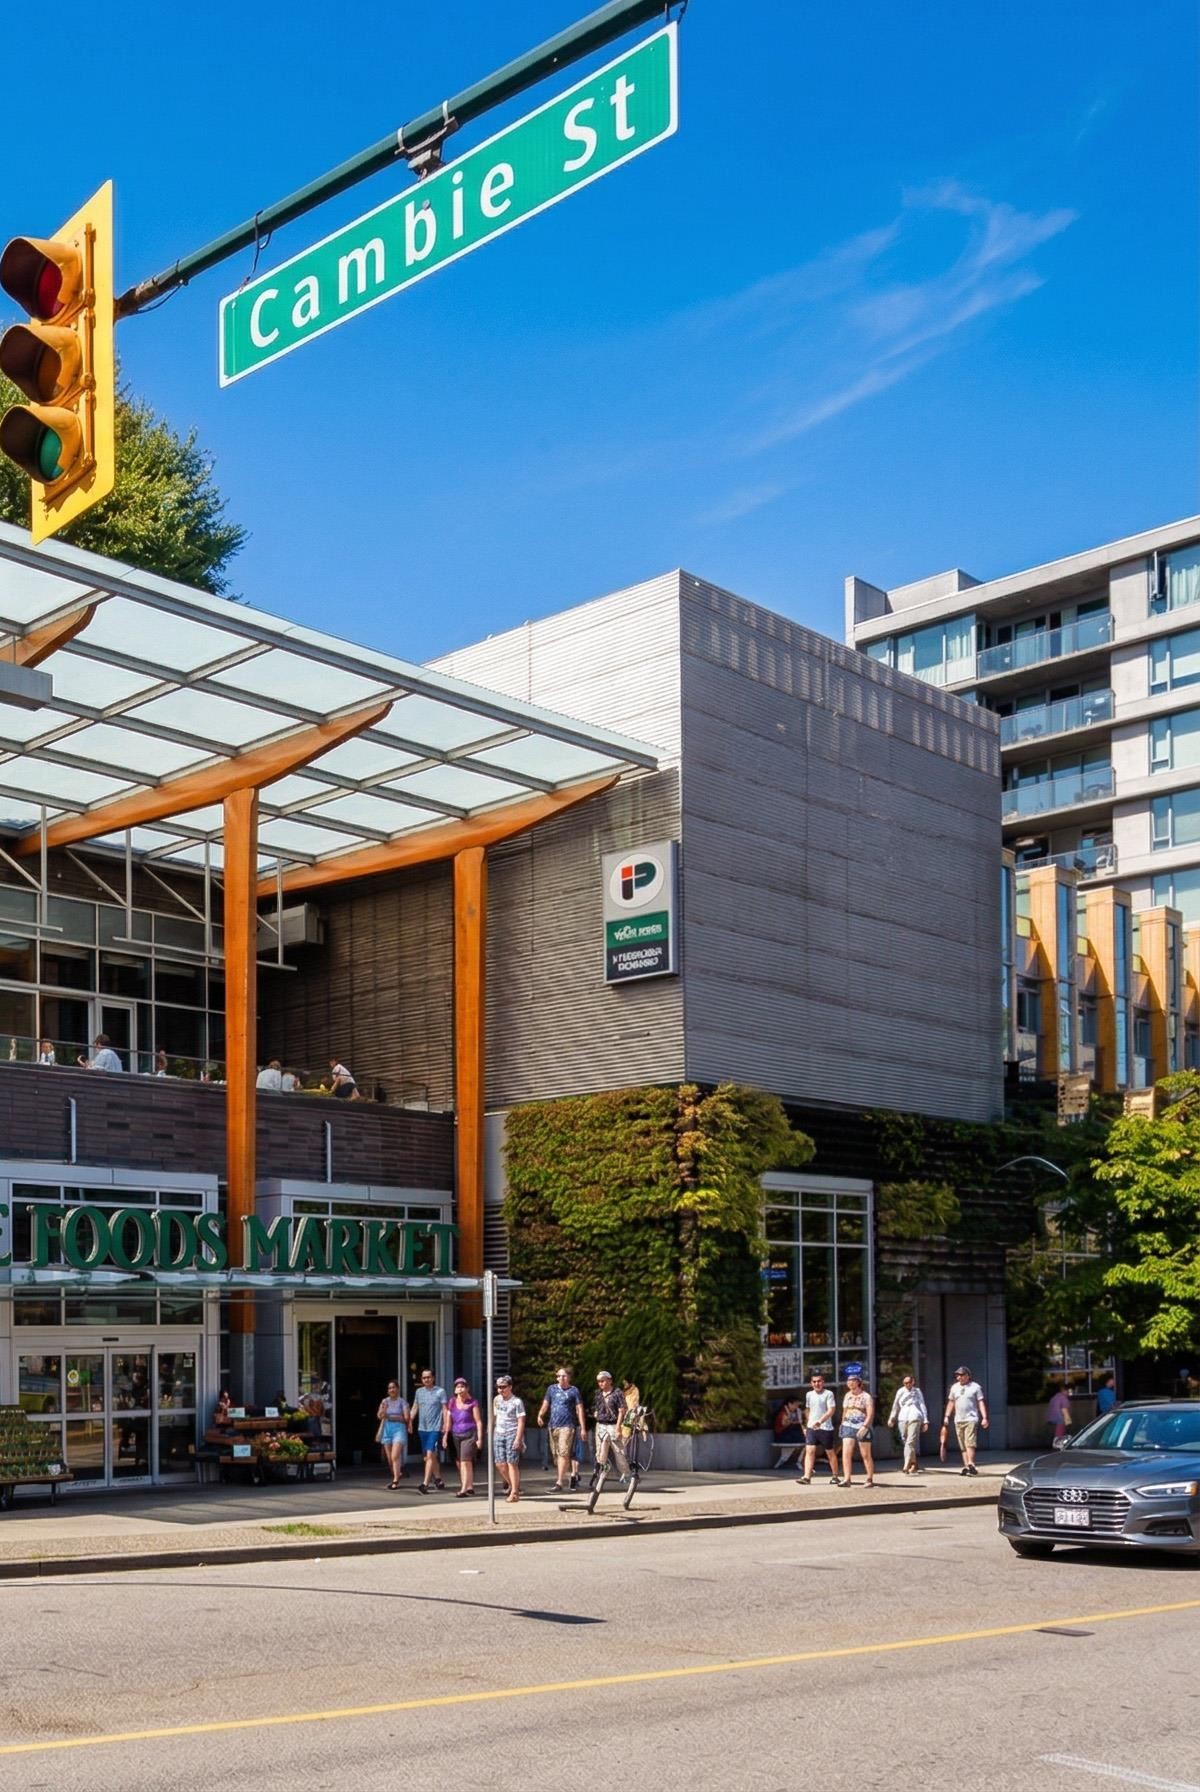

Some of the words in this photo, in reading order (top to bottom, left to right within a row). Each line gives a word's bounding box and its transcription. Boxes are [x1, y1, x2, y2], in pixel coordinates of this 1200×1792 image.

[250, 162, 515, 348] Cambie
[563, 74, 635, 172] St
[26, 1204, 228, 1271] FOODS
[241, 1215, 460, 1276] MARKET
